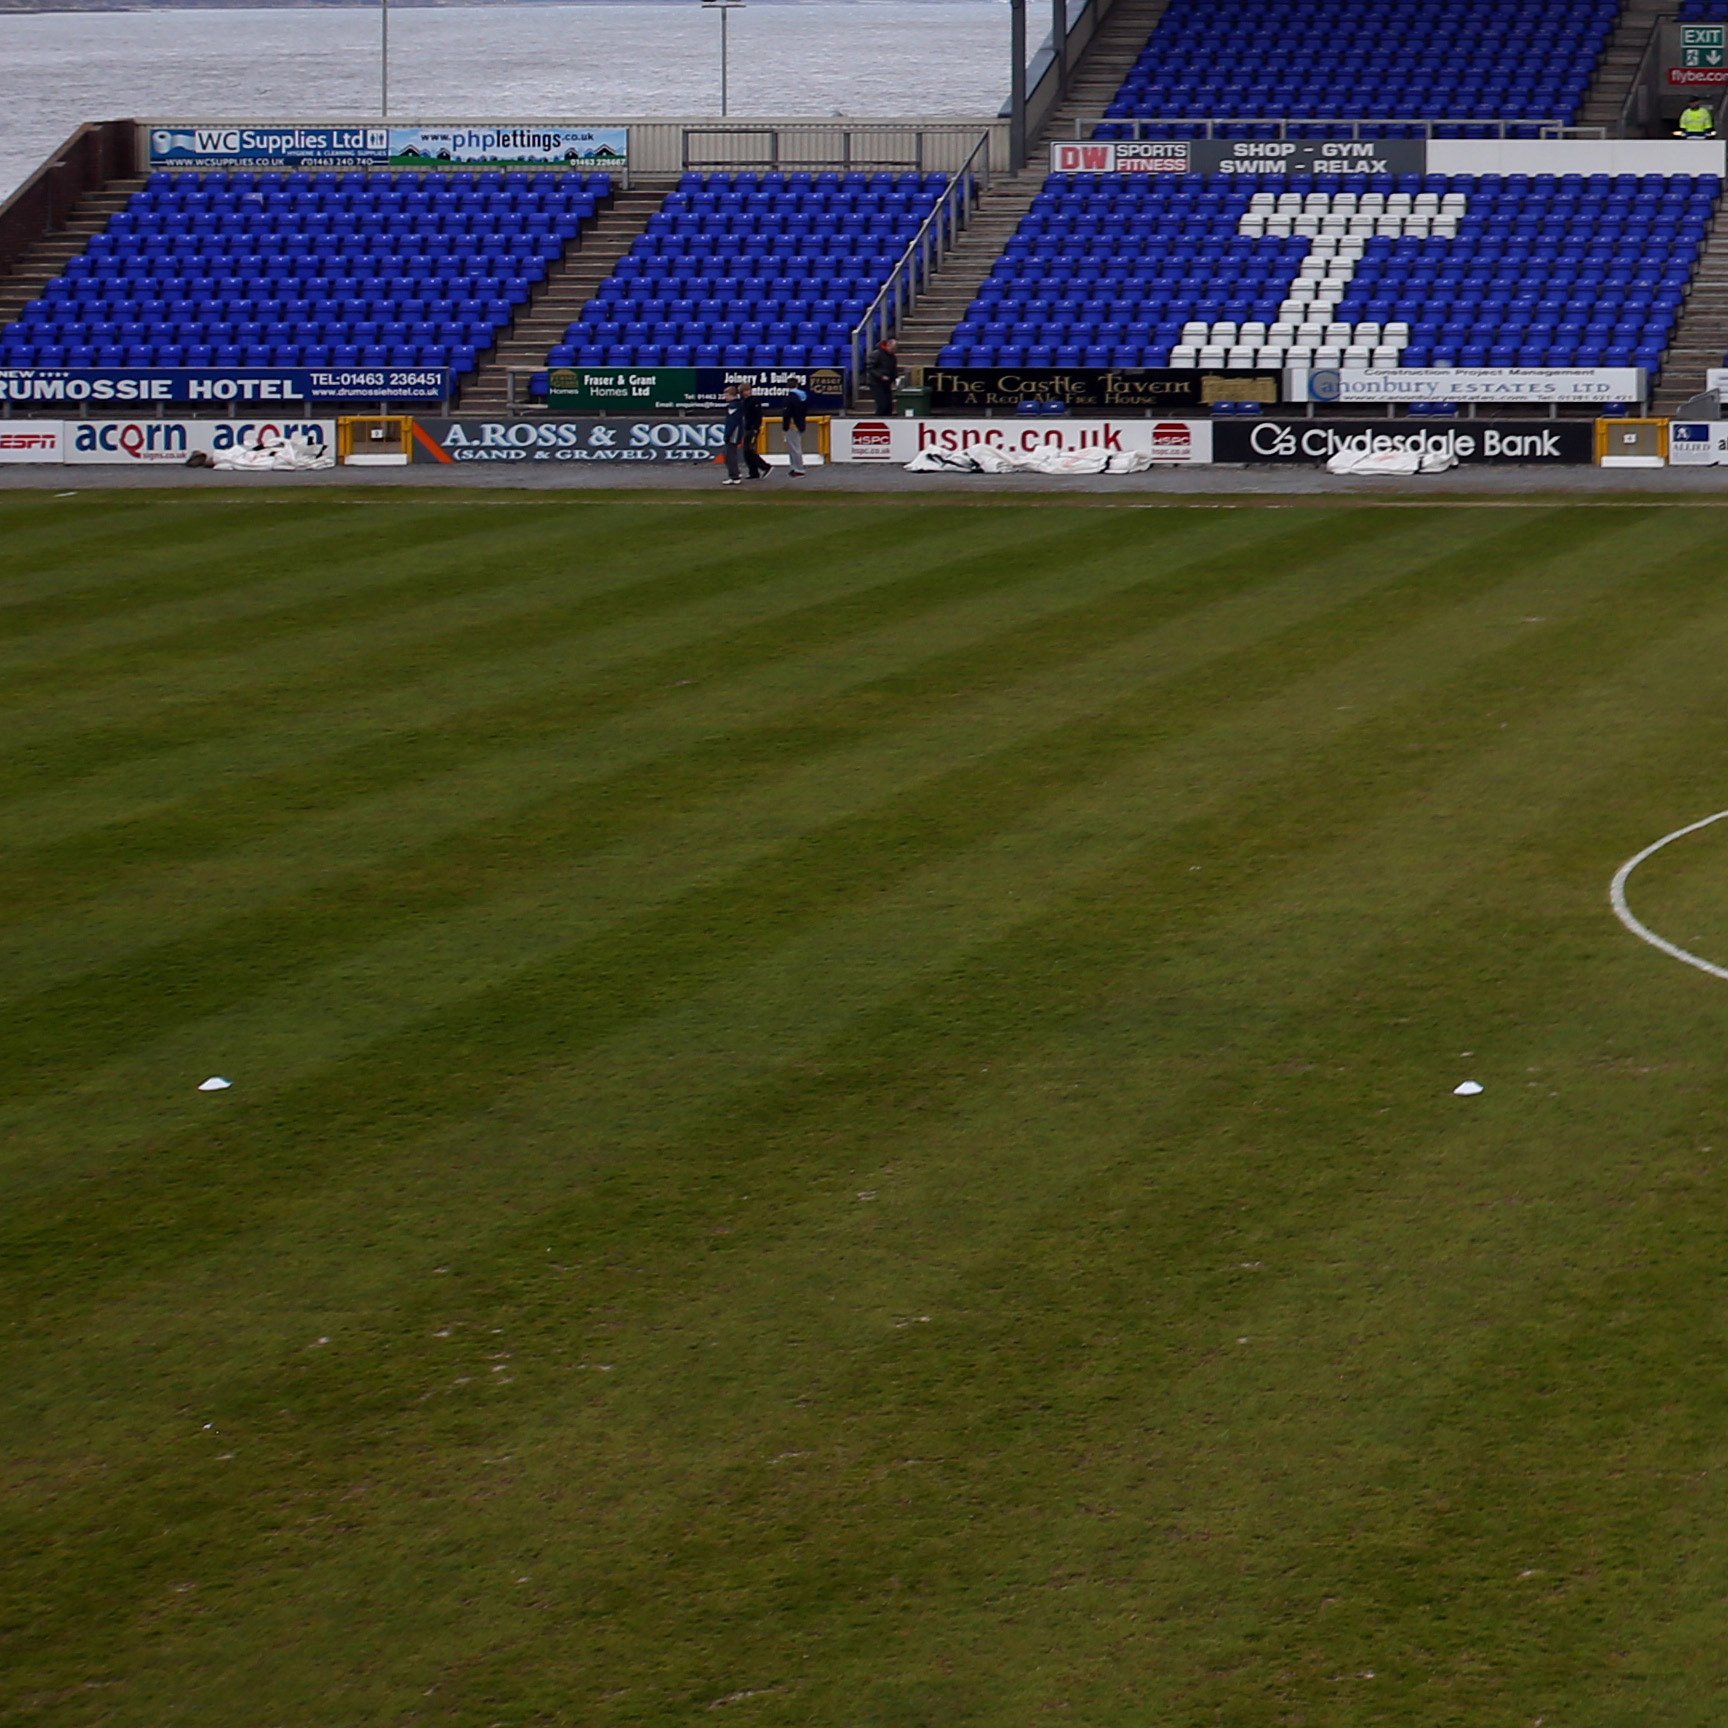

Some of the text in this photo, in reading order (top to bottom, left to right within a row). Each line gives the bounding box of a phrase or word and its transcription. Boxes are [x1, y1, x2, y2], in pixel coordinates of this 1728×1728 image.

[1684, 30, 1721, 43] EXIT
[198, 131, 364, 154] WC Supplies Ltd
[1117, 144, 1187, 157] SPORTS
[1233, 144, 1374, 156] SHOP GYM
[1060, 146, 1109, 170] DW
[1116, 159, 1187, 171] FITNESS
[1220, 160, 1388, 173] SWIM RELAX
[390, 373, 441, 385] 236451
[584, 375, 614, 385] Fraser
[629, 375, 656, 385] Grant
[724, 373, 756, 385] Joinery
[928, 374, 1192, 393] The Castle Tavern
[189, 379, 303, 400] HOTEL
[590, 387, 650, 396] Homes Ltd
[1451, 382, 1610, 393] ESTATES LTD
[75, 424, 186, 458] acorn
[441, 423, 727, 447] A.ROSS & SONS
[853, 436, 889, 445] HSPC
[1301, 429, 1562, 456] Clydesdale Bank
[1673, 443, 1711, 451] ALLIED
[143, 452, 188, 461] signs.co.uk
[453, 448, 715, 461] (SAND GRAVEL) LTD.
